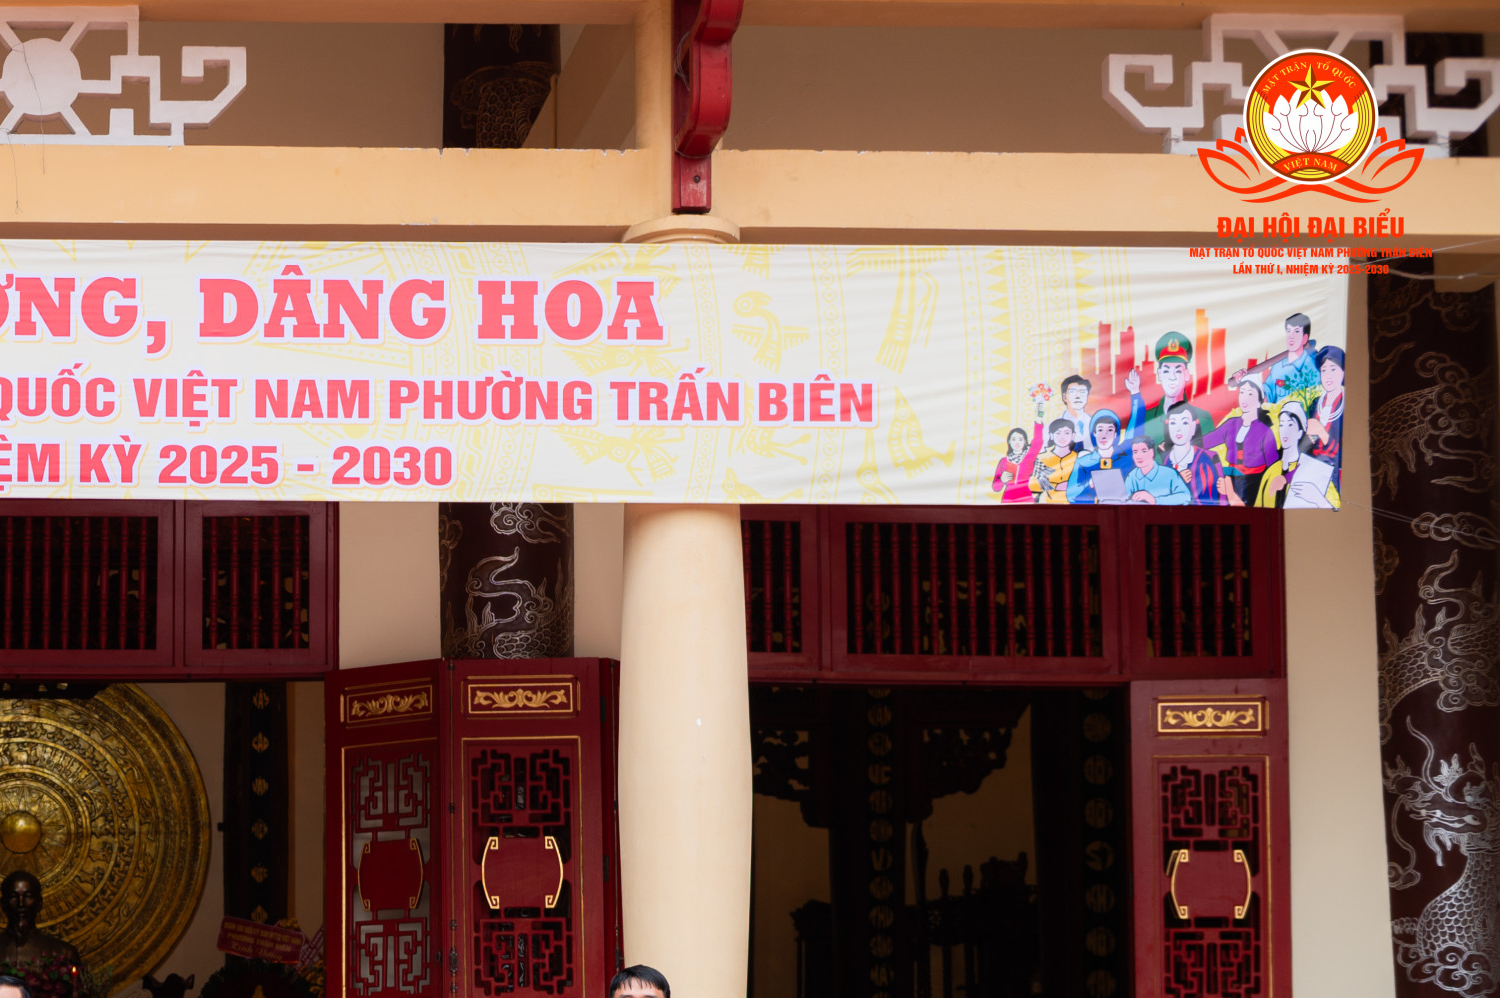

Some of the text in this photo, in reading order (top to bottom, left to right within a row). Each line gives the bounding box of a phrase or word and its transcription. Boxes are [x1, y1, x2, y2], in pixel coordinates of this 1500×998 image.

[199, 264, 447, 340] DÂNG
[477, 279, 664, 341] HOA
[132, 369, 238, 427] VIỆT
[254, 378, 370, 419] NAM
[389, 370, 593, 421] PHƯỜNG
[609, 367, 740, 422] TRẤN
[758, 373, 873, 422] BIÊN
[79, 434, 142, 484] KỲ
[158, 444, 279, 485] 2025
[331, 445, 452, 486] 2030
